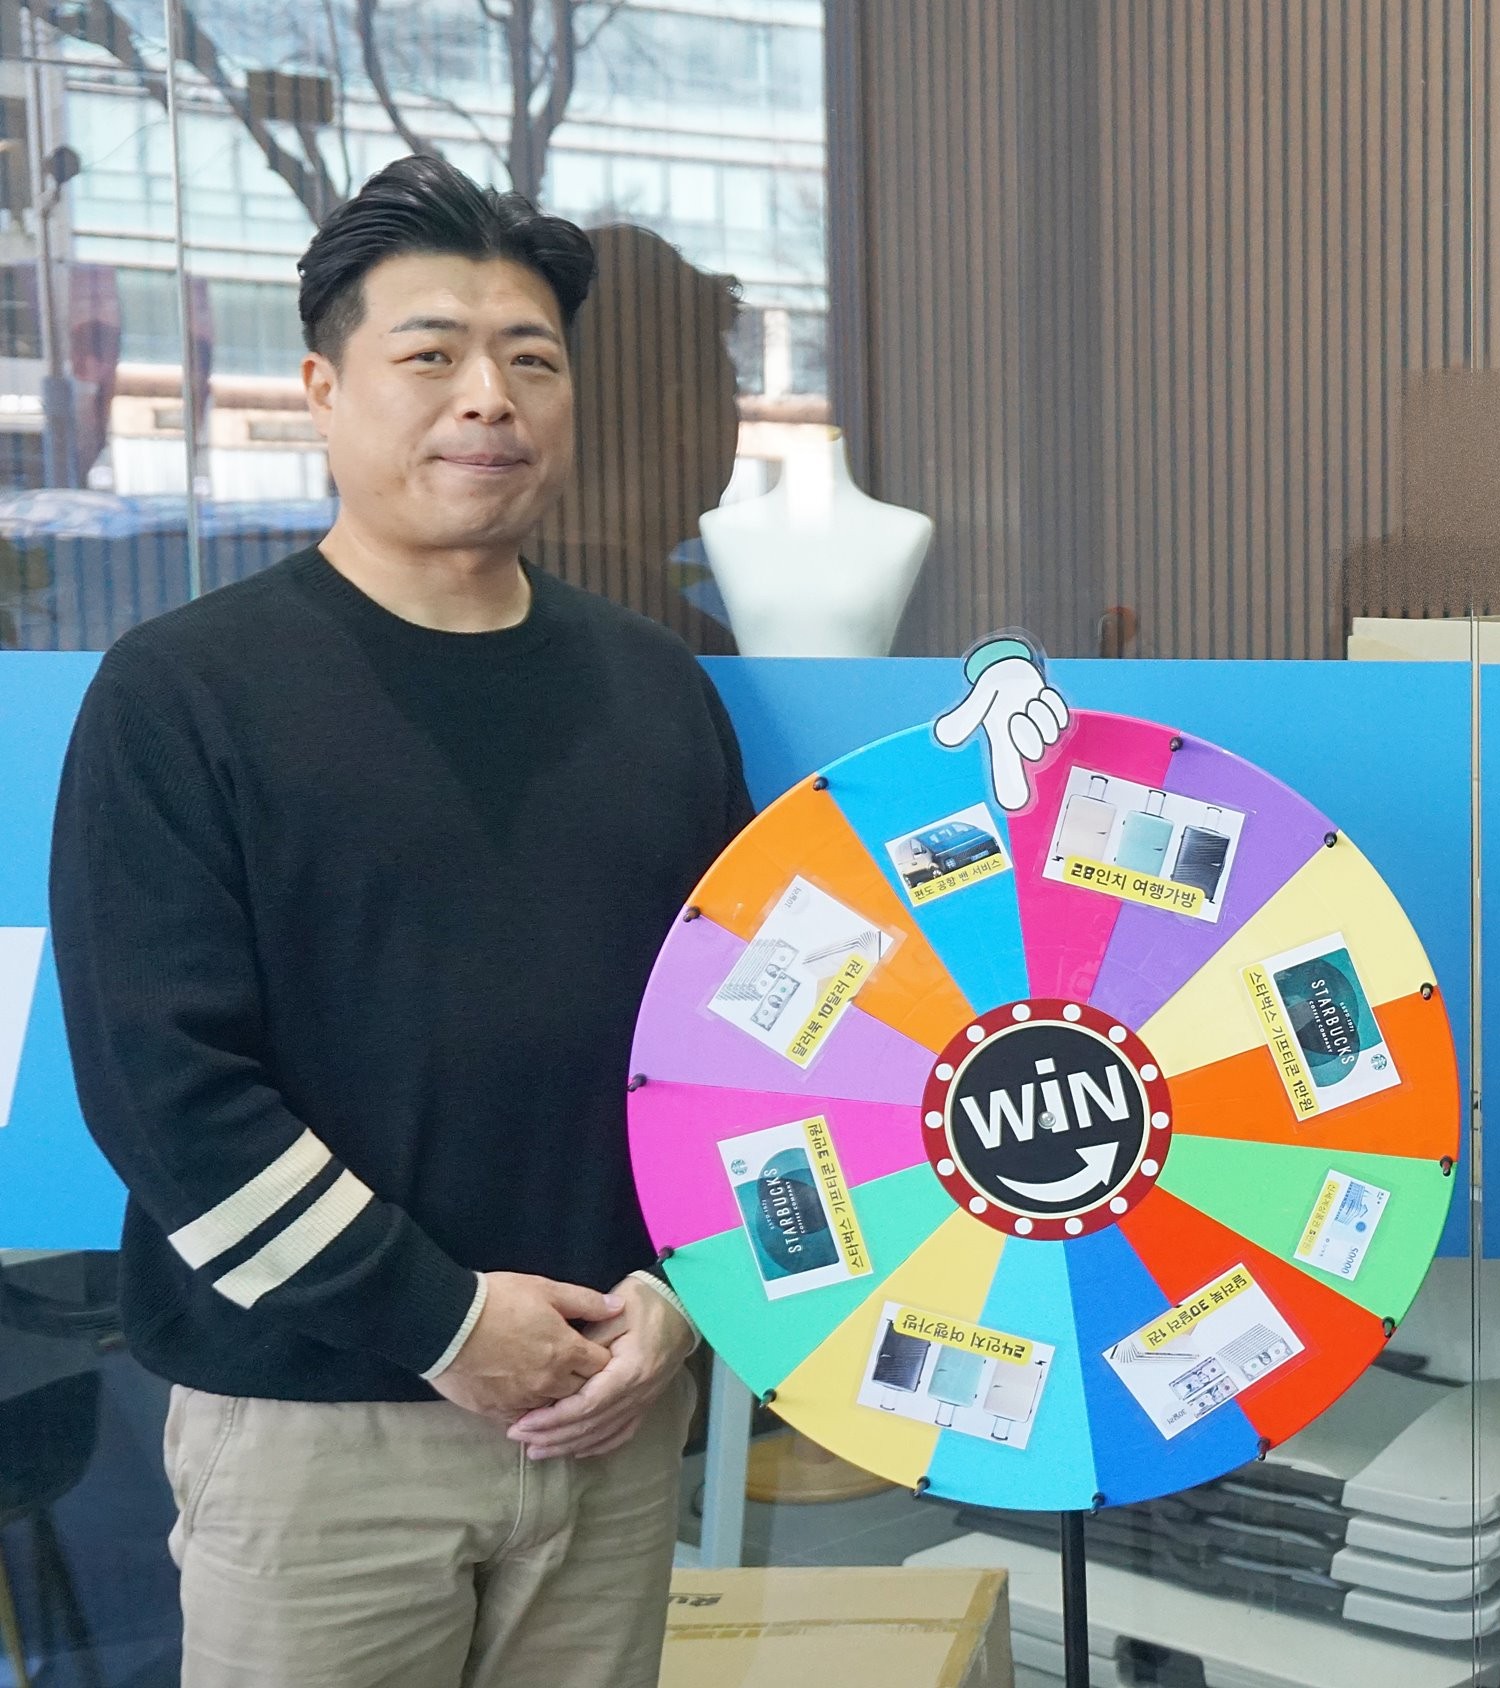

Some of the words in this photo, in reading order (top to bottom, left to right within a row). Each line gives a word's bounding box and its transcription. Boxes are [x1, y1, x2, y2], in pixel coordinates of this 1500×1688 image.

[914, 886, 934, 900] 편도
[936, 876, 956, 890] 공항
[973, 859, 1001, 875] 서비스
[1070, 861, 1127, 890] 28인치
[1133, 878, 1197, 908] 여행가방
[792, 1020, 822, 1056] 달러북
[818, 980, 849, 1018] 10달러
[845, 960, 863, 978] 1권
[1309, 1001, 1320, 1022] COFFEE
[1319, 1024, 1332, 1052] COMPANY
[1312, 980, 1356, 1064] STARBUCKS
[1250, 972, 1276, 1023] 스타벅스
[1272, 1026, 1300, 1076] 기프티콘
[1293, 1080, 1314, 1112] 1만원
[808, 1123, 829, 1159] 3만원
[764, 1168, 802, 1254] STARBUCKS
[821, 1163, 845, 1214] 기프티콘
[840, 1218, 864, 1268] 스타벅스
[1210, 1274, 1247, 1304] 달러북
[902, 1314, 964, 1342] 여행가방
[1147, 1329, 1166, 1346] 1권
[1166, 1299, 1209, 1332] 30달러
[970, 1332, 1025, 1358] 24인치
